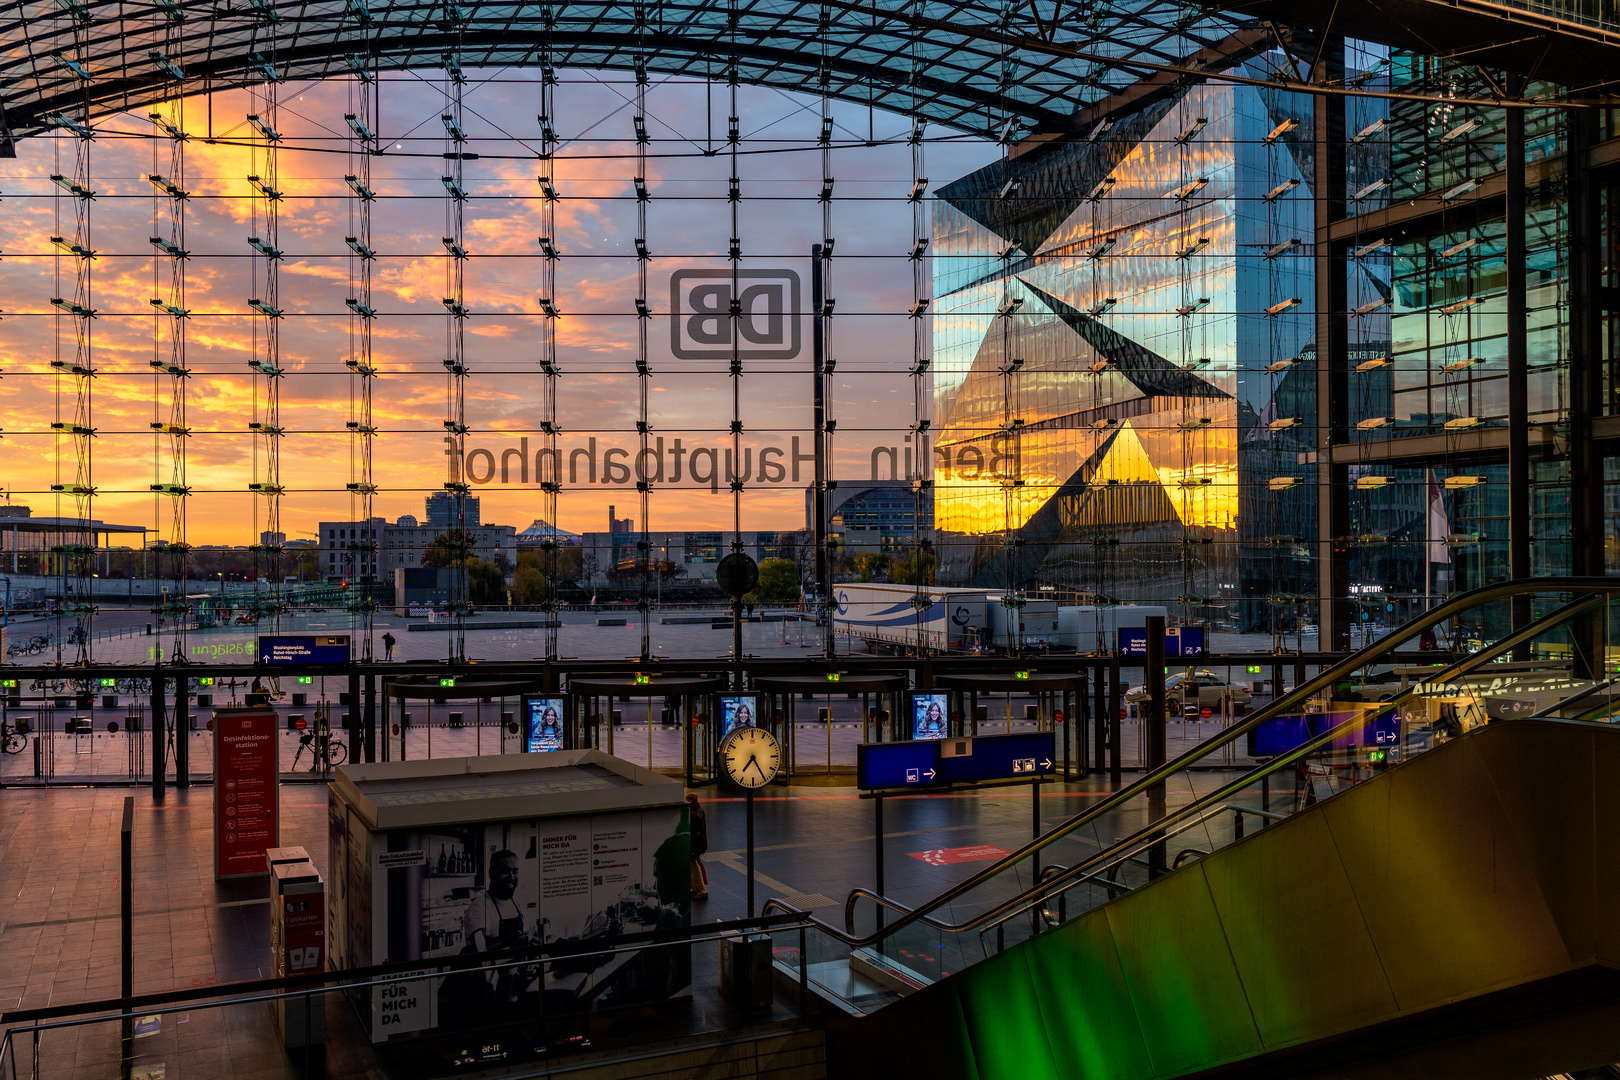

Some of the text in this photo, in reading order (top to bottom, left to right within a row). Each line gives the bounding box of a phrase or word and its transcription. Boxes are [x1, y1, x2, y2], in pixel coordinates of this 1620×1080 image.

[286, 914, 318, 923] Fahrkarten
[382, 985, 407, 999] FÜR
[382, 998, 416, 1012] MICH
[382, 1014, 401, 1025] DA
